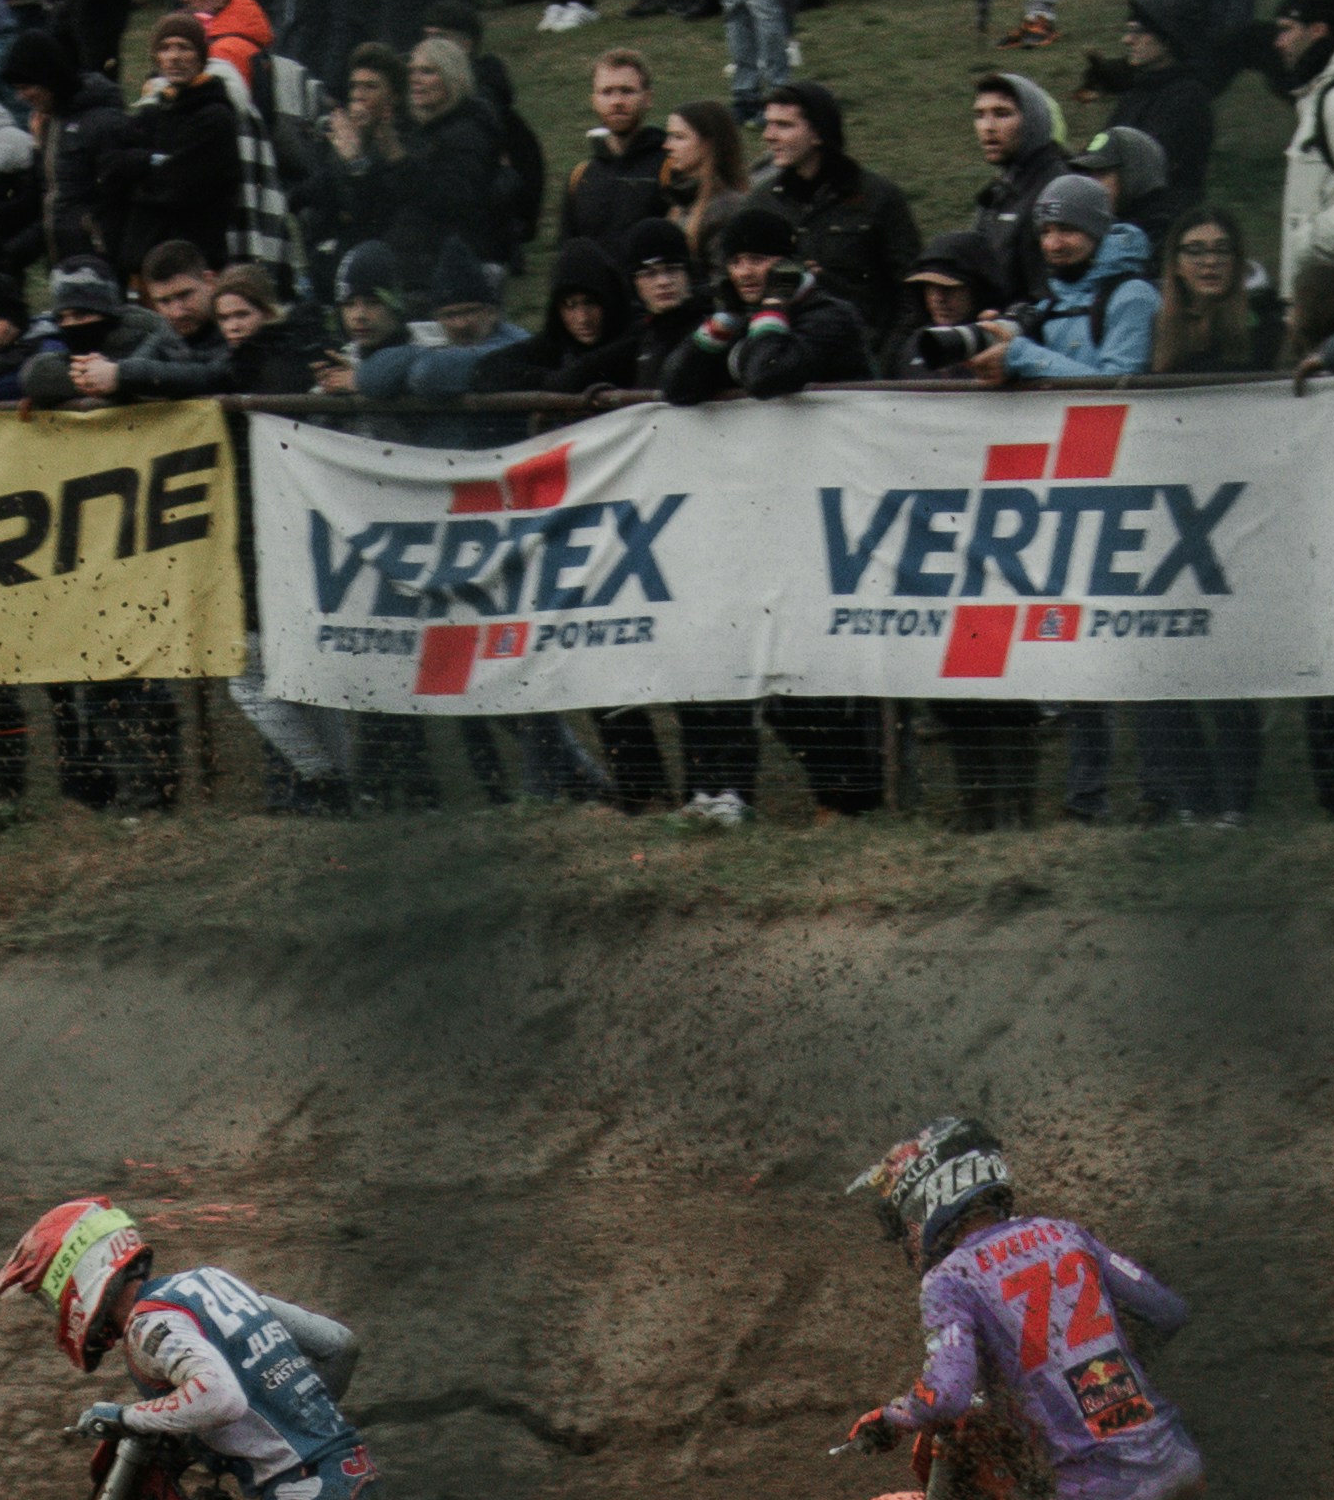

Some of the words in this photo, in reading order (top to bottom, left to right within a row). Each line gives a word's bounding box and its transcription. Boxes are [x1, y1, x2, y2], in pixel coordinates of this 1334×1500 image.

[309, 493, 690, 620] VERTEX
[819, 481, 1248, 597] VERTEX
[532, 615, 656, 652] POWER
[828, 607, 948, 636] PISTON
[1087, 608, 1212, 638] POWER
[999, 1249, 1114, 1372] 72
